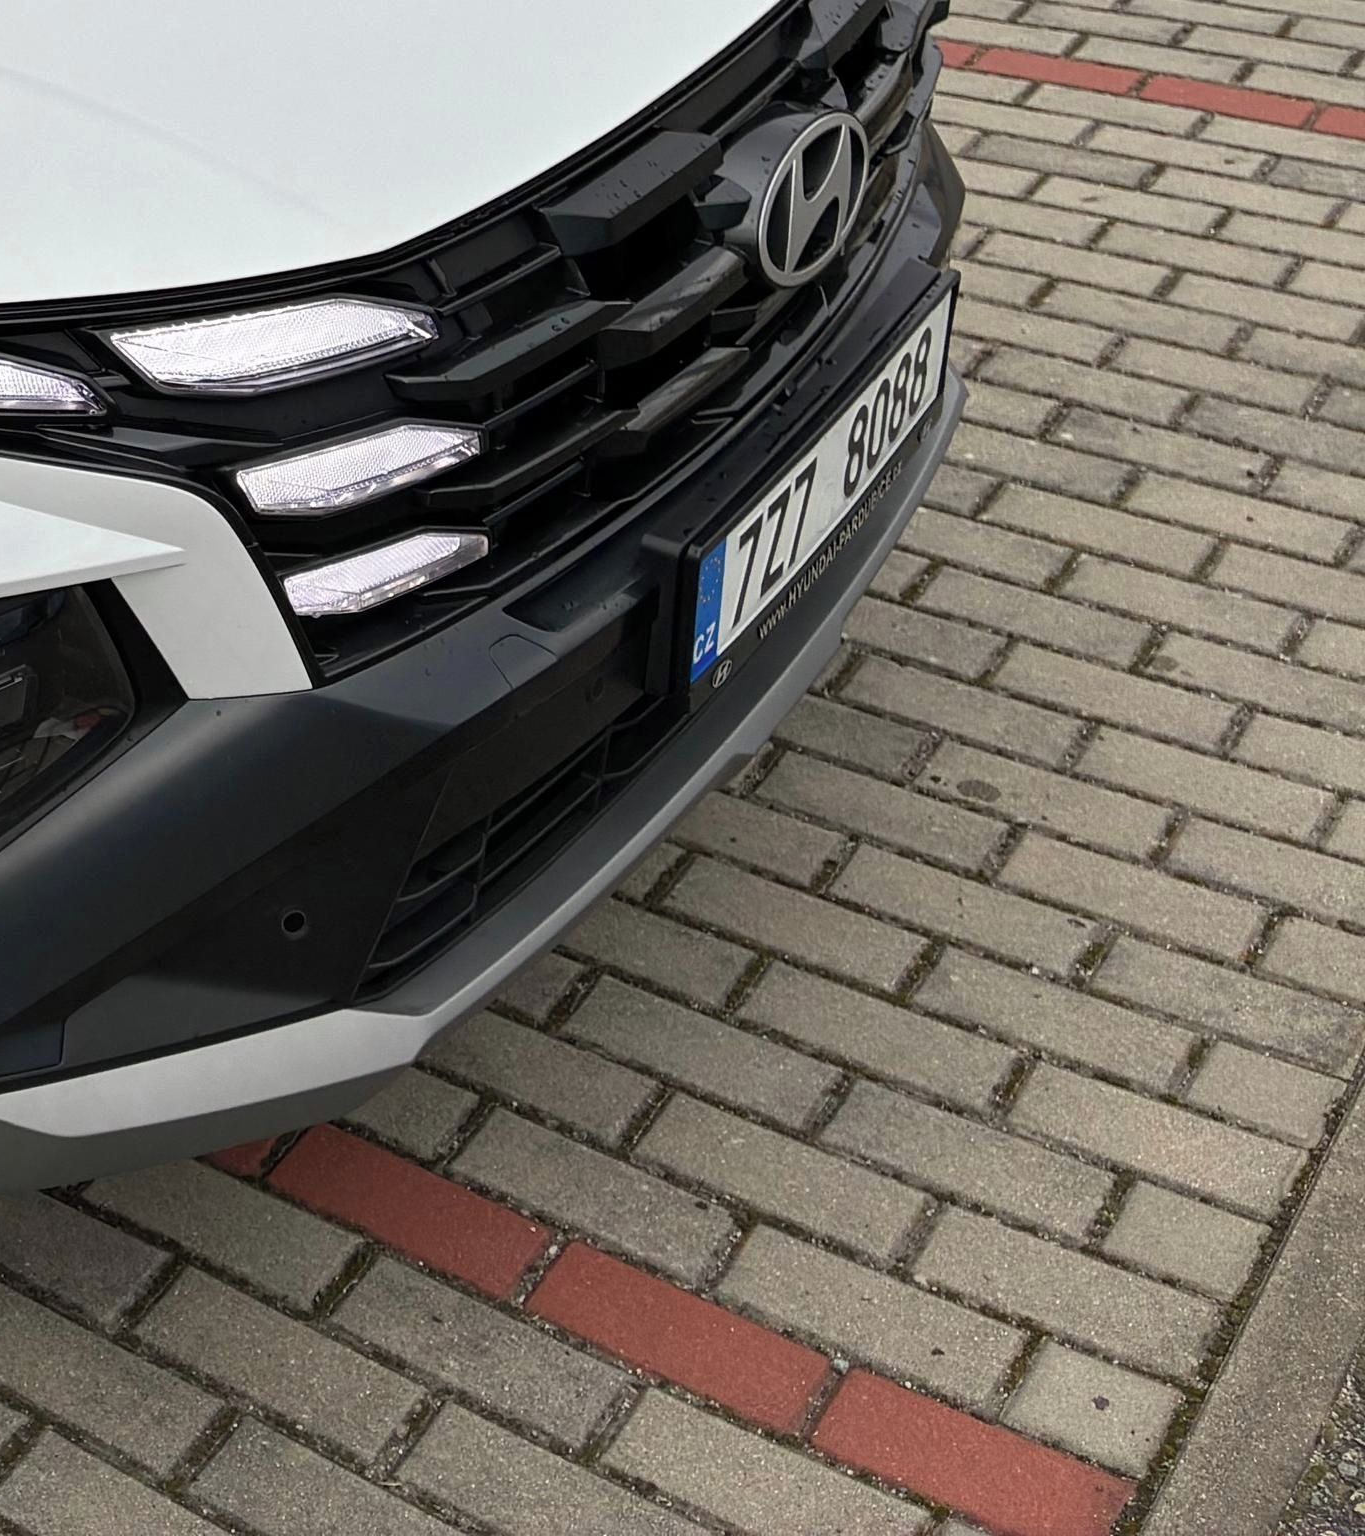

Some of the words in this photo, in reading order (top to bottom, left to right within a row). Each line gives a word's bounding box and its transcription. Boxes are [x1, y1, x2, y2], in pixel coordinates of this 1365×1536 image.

[733, 458, 818, 630] 7Z7
[843, 326, 932, 499] 8088
[692, 620, 717, 665] CZ
